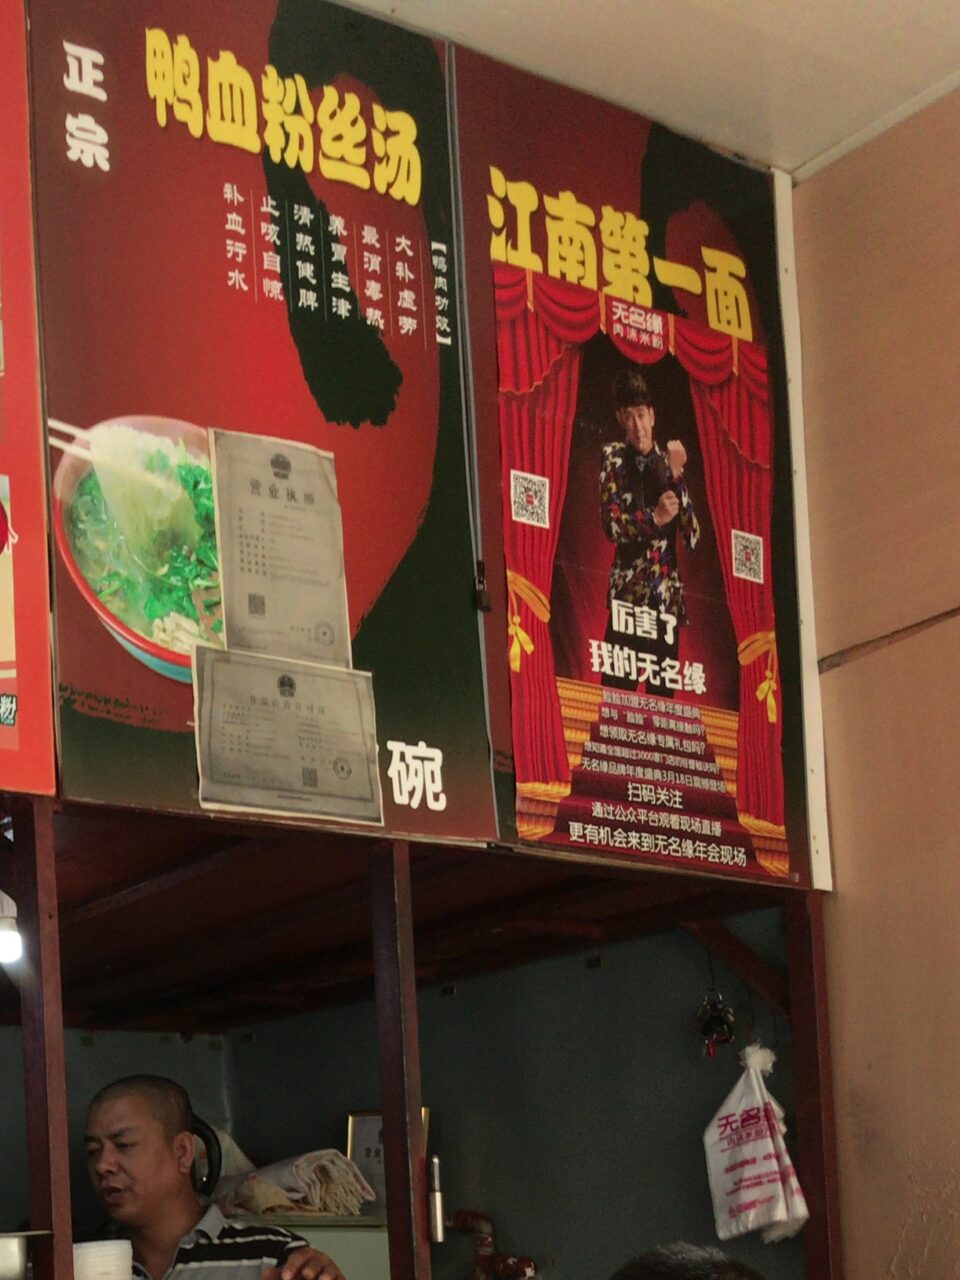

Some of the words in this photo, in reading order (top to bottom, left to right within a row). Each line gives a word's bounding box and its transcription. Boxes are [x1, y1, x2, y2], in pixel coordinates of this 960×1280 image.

[62, 39, 110, 172] 正宗
[145, 27, 422, 207] 鸭血粉丝汤
[223, 182, 249, 293] 补血行水
[260, 195, 284, 302] 止咳自惊
[293, 203, 319, 312] 清热健脾
[361, 224, 386, 331] 最消毒热
[394, 234, 418, 336] 大补虚劳
[486, 165, 753, 343] 江南第一面
[589, 640, 708, 695] 我的无名缘
[611, 599, 678, 645] 厉害了
[386, 740, 447, 811] 碗
[591, 801, 722, 837] 通过公众平台观看现场直播
[627, 782, 683, 809] 扫码关注
[569, 822, 746, 868] 更有机会来到无名缘年会现场
